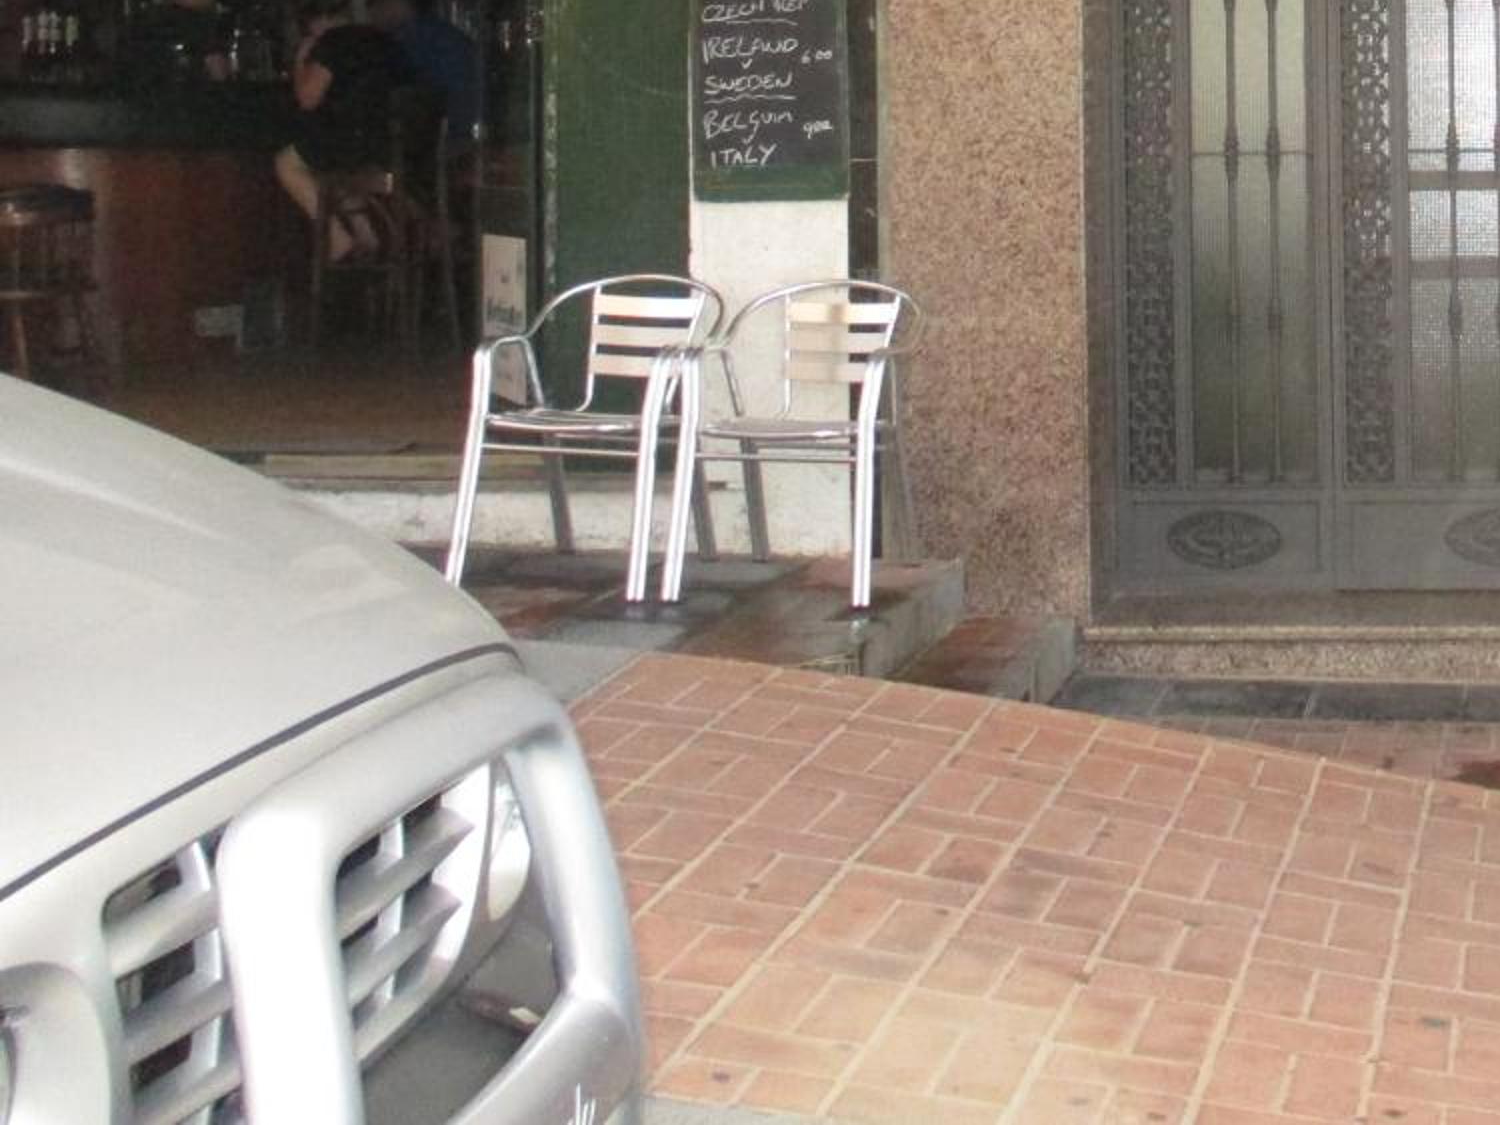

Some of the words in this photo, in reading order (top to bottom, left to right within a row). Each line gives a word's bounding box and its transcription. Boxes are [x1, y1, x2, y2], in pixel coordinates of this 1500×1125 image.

[703, 36, 799, 65] IRELAND
[703, 72, 793, 95] SWEDEN
[710, 143, 777, 168] ITALY
